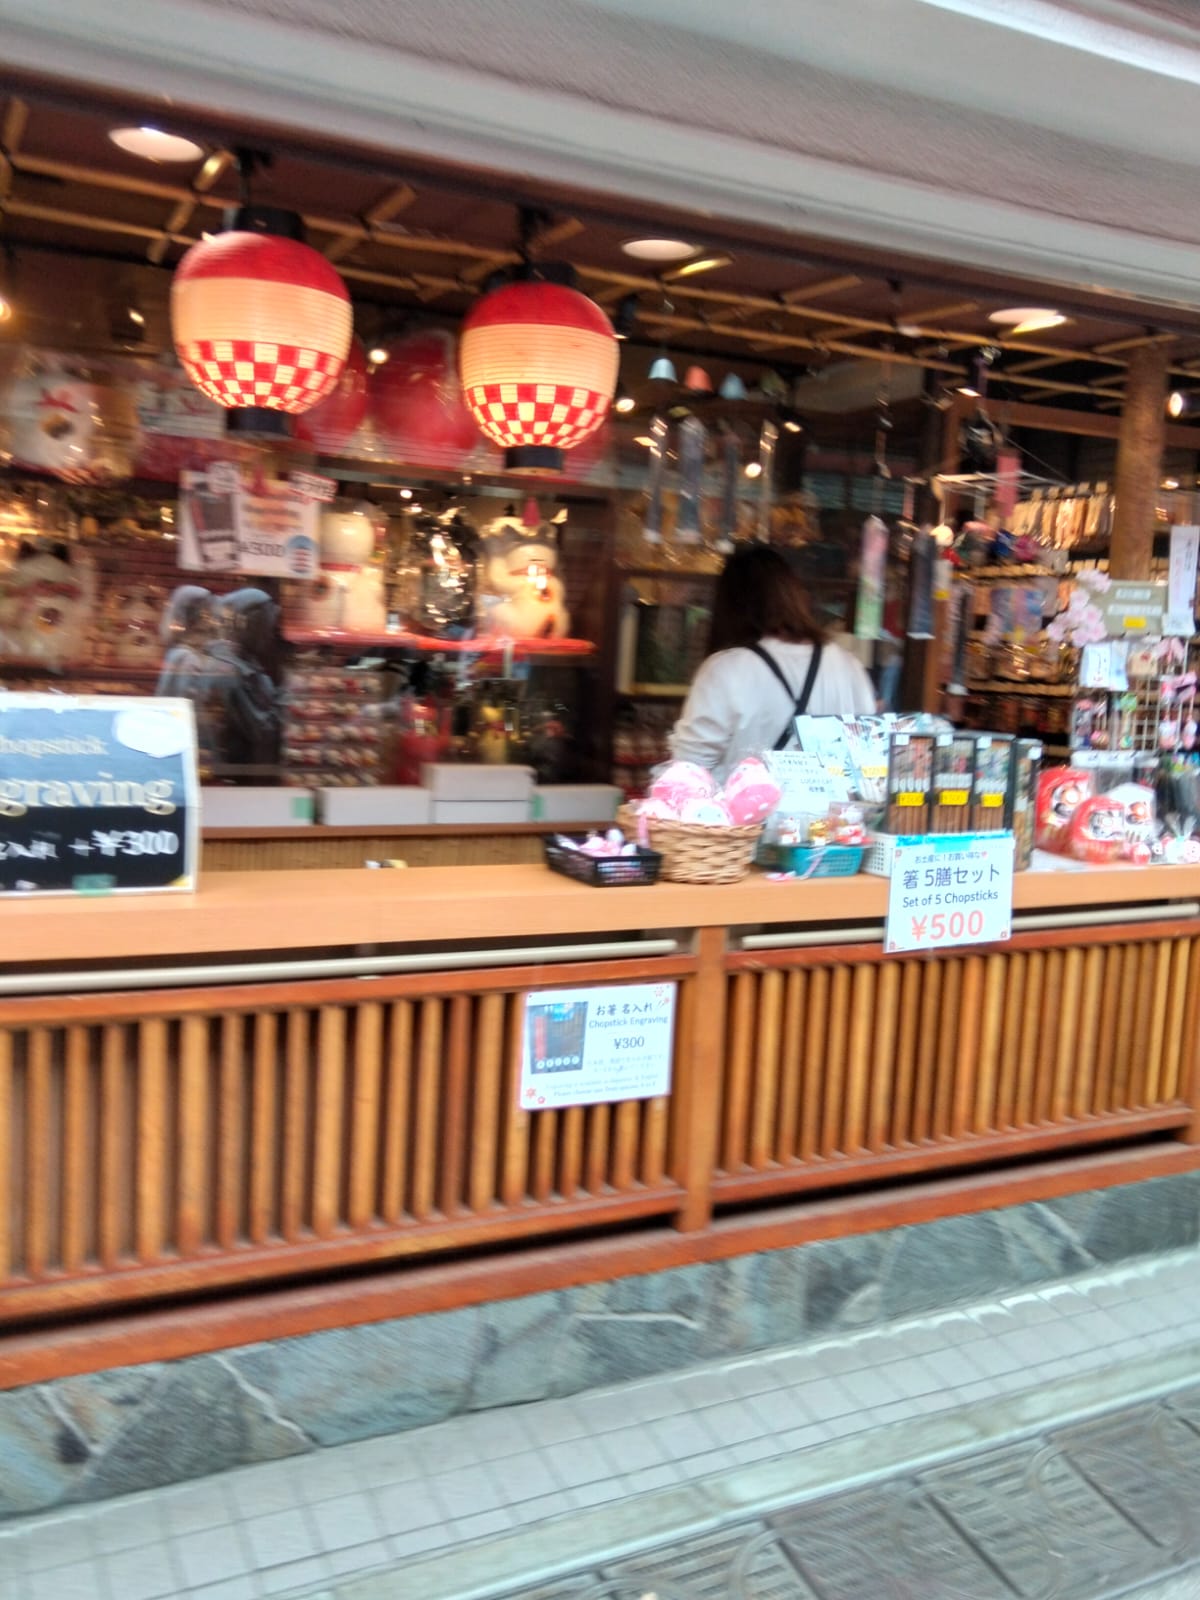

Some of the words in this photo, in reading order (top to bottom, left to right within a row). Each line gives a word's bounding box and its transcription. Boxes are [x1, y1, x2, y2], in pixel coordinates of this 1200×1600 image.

[903, 896, 919, 908] Set
[921, 894, 933, 906] of
[935, 894, 942, 905] 5
[945, 890, 998, 904] Chopsticks
[911, 910, 984, 942] ¥500
[588, 1017, 628, 1029] Chopstick
[630, 1014, 668, 1026] Engraving
[613, 1035, 645, 1049] ¥300
